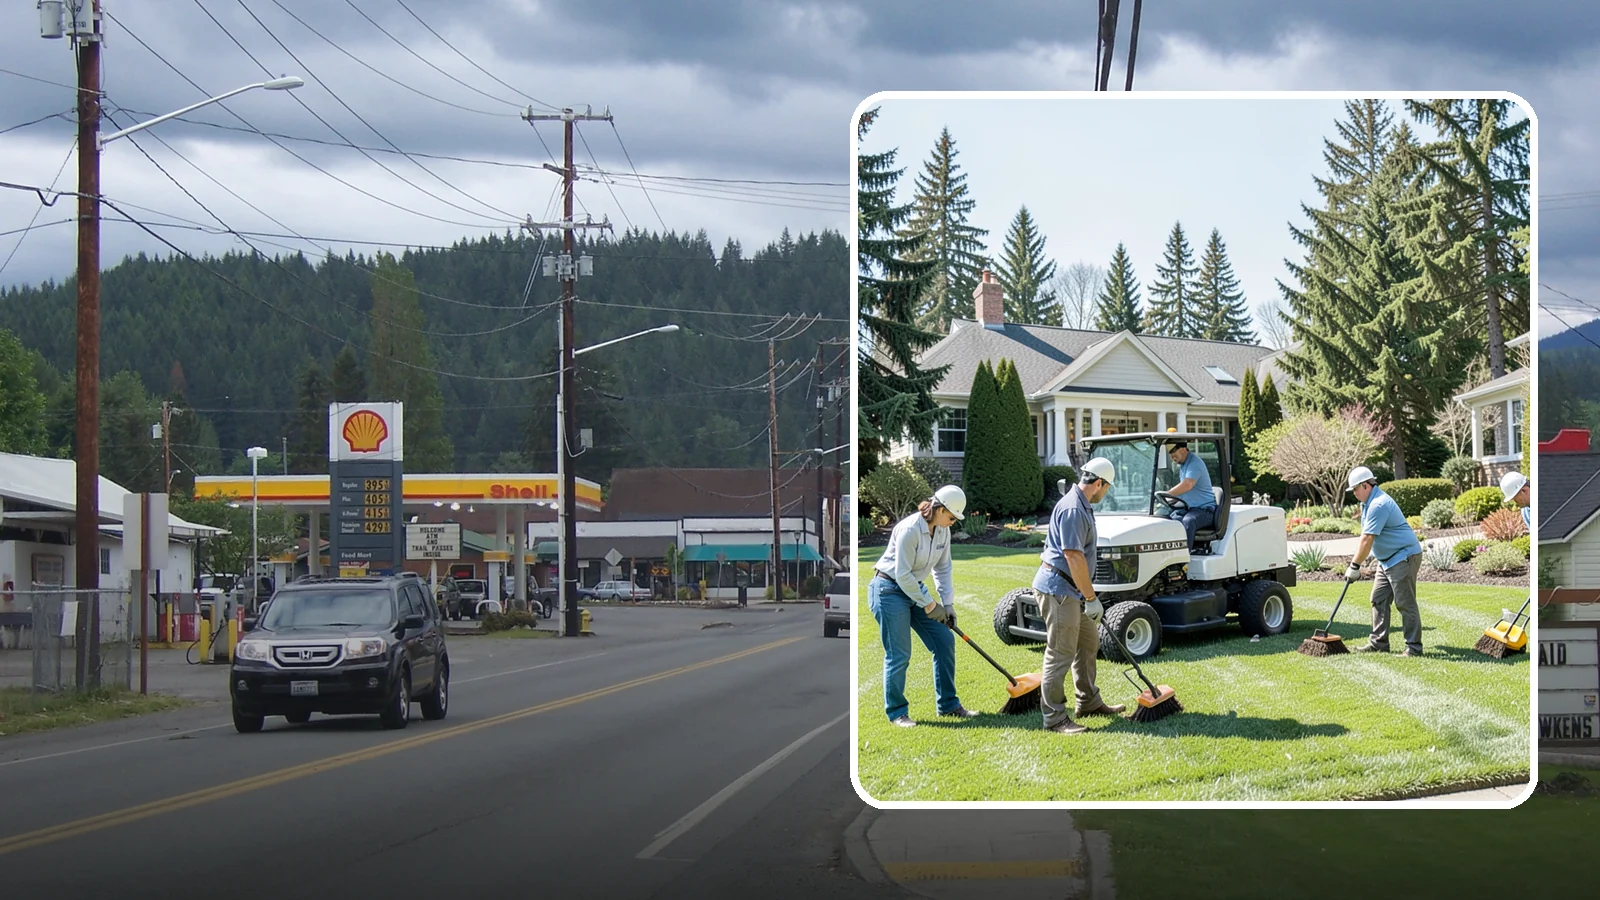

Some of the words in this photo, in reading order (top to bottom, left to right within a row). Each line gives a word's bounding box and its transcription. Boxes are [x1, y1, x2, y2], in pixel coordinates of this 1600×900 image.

[366, 480, 384, 490] 395
[490, 484, 547, 499] Shell
[366, 494, 384, 504] 405
[366, 508, 384, 518] 415
[366, 522, 384, 532] 429
